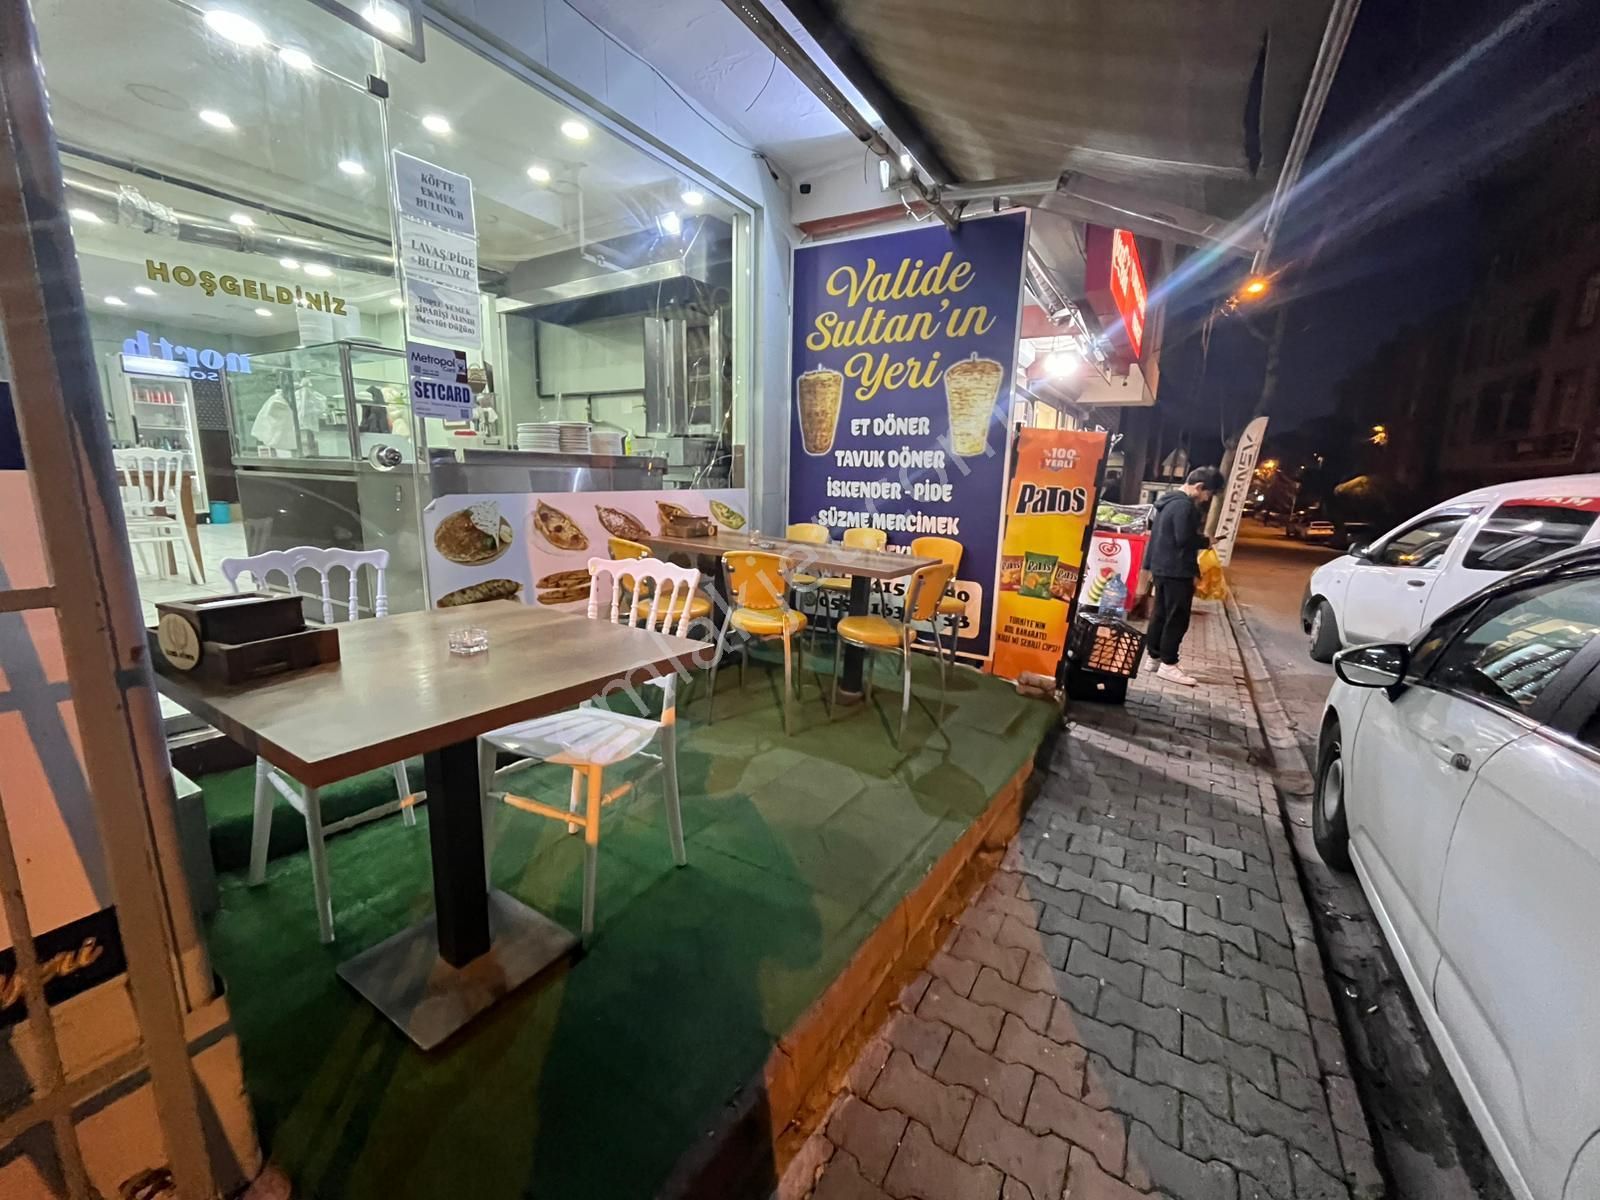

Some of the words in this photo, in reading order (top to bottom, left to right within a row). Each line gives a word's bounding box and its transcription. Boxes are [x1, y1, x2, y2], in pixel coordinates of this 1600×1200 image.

[415, 197, 464, 220] BULUNUR
[418, 256, 471, 280] BULUNUR
[826, 252, 976, 308] Valide
[145, 259, 348, 316] HOŞGELDİNİZ
[411, 351, 456, 368] Metropol
[844, 351, 943, 401] Yeri
[414, 380, 471, 404] SETCARD
[850, 418, 871, 436] ET
[873, 413, 930, 437] DÖNER
[834, 449, 885, 468] TAVUK
[887, 446, 946, 469] DÖNER
[826, 476, 902, 500] İSKENDER
[913, 479, 953, 502] PİDE
[817, 507, 871, 528] SÜZME
[872, 511, 960, 535] MERCİMEK
